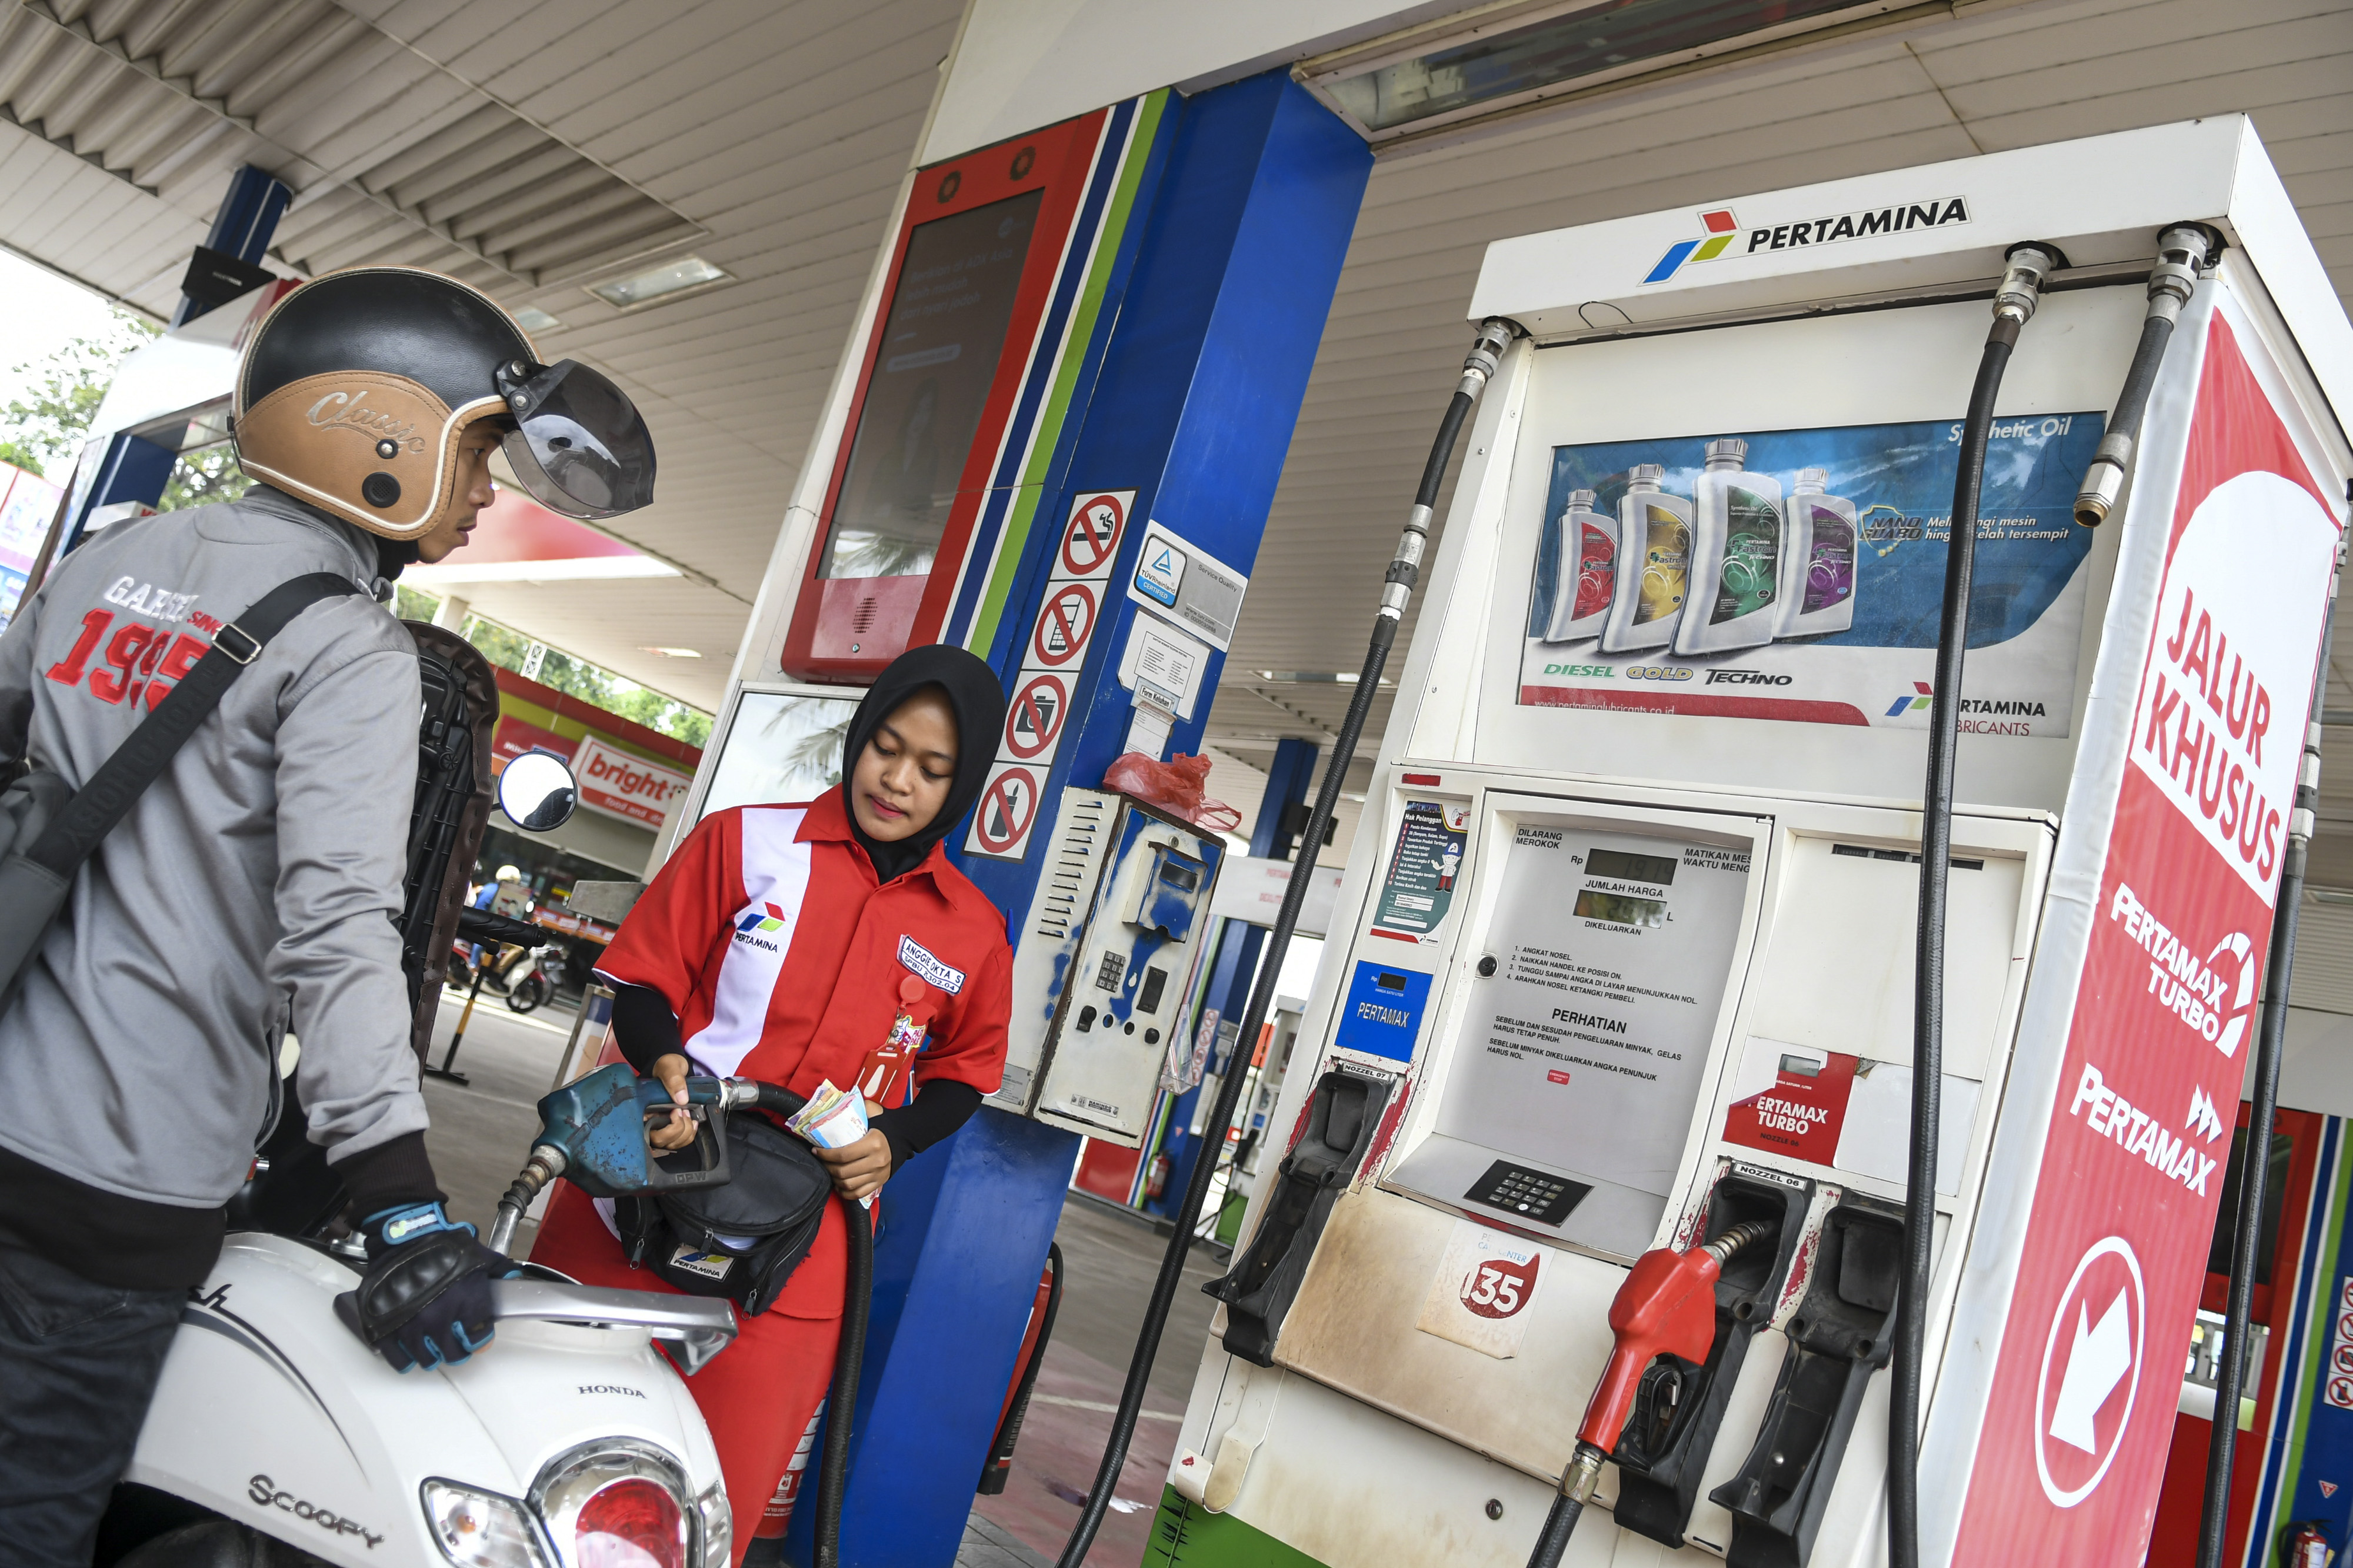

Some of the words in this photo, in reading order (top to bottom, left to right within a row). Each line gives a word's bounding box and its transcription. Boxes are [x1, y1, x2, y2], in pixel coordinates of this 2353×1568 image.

[1747, 198, 1967, 253] PERTAMINA
[306, 391, 425, 454] Classic
[1948, 420, 2034, 446] Shetic
[2041, 416, 2072, 436] Oil
[1871, 517, 1922, 529] NANO
[1927, 515, 1997, 530] Melngi
[1999, 515, 2037, 526] mesin
[1859, 528, 1922, 541] GUARD
[2009, 529, 2069, 542] tersempit
[1738, 545, 1776, 553] Fastron
[1198, 564, 1218, 581] Service
[1219, 577, 1238, 593] Quality
[1143, 582, 1168, 600] CERTIFIED
[1185, 606, 1215, 626] www.tuv.com
[1544, 664, 1616, 678] DIESEL
[1625, 666, 1694, 682] GOLD
[1704, 668, 1793, 685] TECHNO
[2167, 586, 2271, 769] JALUR
[1141, 688, 1152, 699] Form
[1153, 692, 1170, 707] Keluhan
[1960, 699, 2046, 716] RTAMINA
[1957, 720, 2029, 736] BRICANTS
[587, 753, 668, 800] bright
[2143, 672, 2280, 883] KHUSUS
[1415, 815, 1442, 824] Pelanggan
[1518, 828, 1562, 840] DILARANG
[1515, 838, 1561, 849] MEROKOK
[1571, 855, 1584, 866] Rp
[1683, 858, 1719, 869] WAKTU
[1685, 848, 1730, 863] MATIKAN
[1585, 880, 1625, 893] JUMLAH
[1627, 885, 1664, 898] HARGA
[1667, 912, 1674, 922] L
[1584, 920, 1642, 936] DIKELUARKAN
[735, 932, 777, 953] PERTAMINA
[2110, 882, 2229, 1011] PERTAMAX
[1522, 947, 1549, 956] ANGKAT
[1549, 951, 1572, 960] NOSEL.
[904, 956, 922, 972] SPBU
[905, 943, 931, 966] ANGGIE
[930, 962, 951, 979] OKTA
[955, 975, 961, 983] S
[1520, 956, 1548, 966] NAIKKAN
[1549, 962, 1575, 972] HANDEL
[1587, 968, 1609, 978] POSISI
[1515, 975, 1546, 986] ARAHKAN
[1547, 981, 1568, 990] NOSEL
[1569, 985, 1603, 997] KETANGKI
[1604, 992, 1635, 1003] PEMBELI.
[1518, 965, 1544, 975] TUNGGU
[1545, 970, 1569, 980] SAMPAI
[1570, 976, 1594, 985] ANGKA
[1603, 981, 1625, 990] LAYAR
[1626, 985, 1680, 1001] MENUNJUKKAN
[1681, 996, 1698, 1005] NOL.
[2147, 967, 2219, 1043] TURBO
[1357, 1002, 1410, 1028] PERTAMAX
[1552, 1008, 1627, 1034] PERHATIAN
[1493, 1023, 1515, 1033] HARUS
[1517, 1029, 1537, 1037] TETAP
[1537, 1033, 1561, 1044] PENUH.
[1495, 1015, 1525, 1027] SEBELUM
[1526, 1022, 1540, 1030] DAN
[1541, 1025, 1572, 1037] SESUDAH
[1573, 1032, 1624, 1048] PENGELUARAN
[1625, 1043, 1653, 1056] MINYAK,
[1657, 1050, 1682, 1060] GELAS
[1487, 1046, 1508, 1056] HARUS
[1509, 1051, 1524, 1060] NOL.
[1489, 1037, 1519, 1050] SEBELUM
[1520, 1045, 1545, 1056] MINYAK
[1545, 1050, 1592, 1066] DIKELUARKAN
[1593, 1062, 1618, 1072] ANGKA
[1619, 1067, 1657, 1081] PENUNJUK
[1345, 1065, 1374, 1076] NOZZEL
[1757, 1096, 1828, 1124] ERTAMAX
[1758, 1111, 1809, 1135] TURBO
[2068, 1062, 2217, 1197] PERTAMAX
[1760, 1133, 1788, 1145] NOZZLE
[1740, 1166, 1783, 1183] NOZZEL
[1786, 1177, 1800, 1186] 06
[674, 1259, 720, 1277] PERTAMINA
[578, 1385, 648, 1400] HONDA
